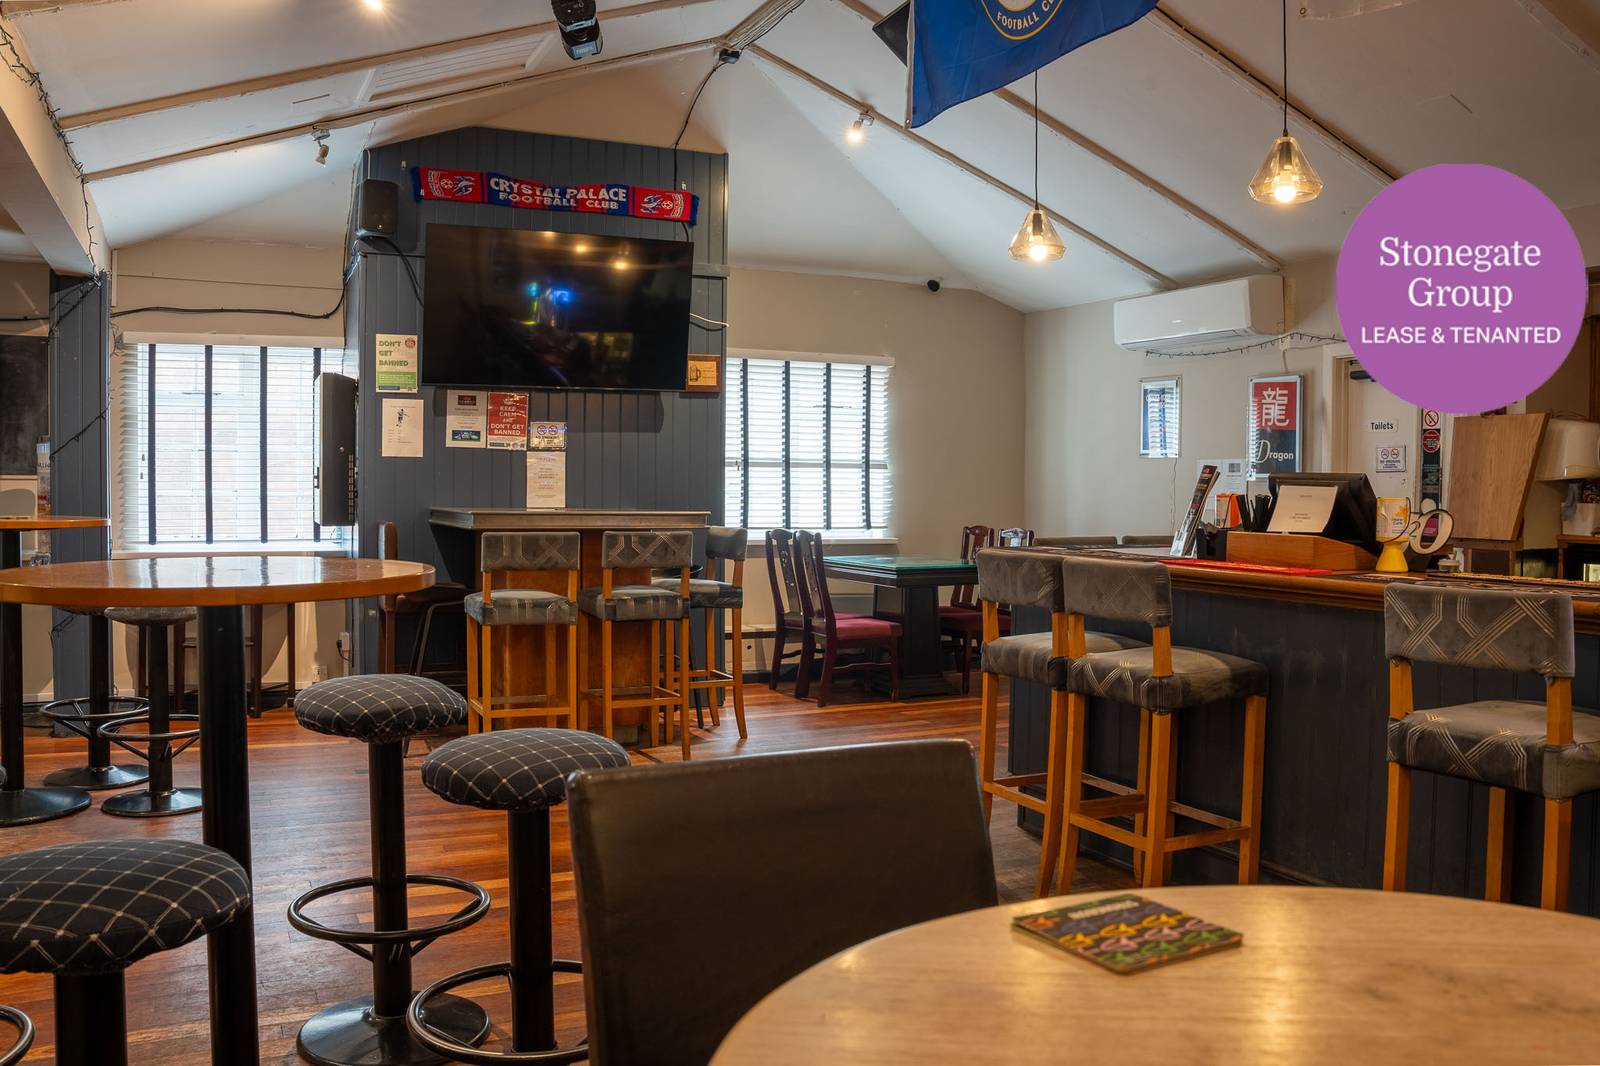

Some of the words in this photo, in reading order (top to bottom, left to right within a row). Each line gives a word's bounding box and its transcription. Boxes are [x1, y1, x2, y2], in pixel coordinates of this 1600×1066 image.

[997, 12, 1039, 30] FOOTBALL
[489, 177, 561, 198] CRYSTAL
[566, 188, 627, 201] PALACE
[499, 191, 577, 207] FOOTBALL
[586, 199, 619, 209] CLUB
[1261, 387, 1289, 427] 龍
[1371, 422, 1394, 430] Toilets
[1255, 439, 1294, 463] Dragon
